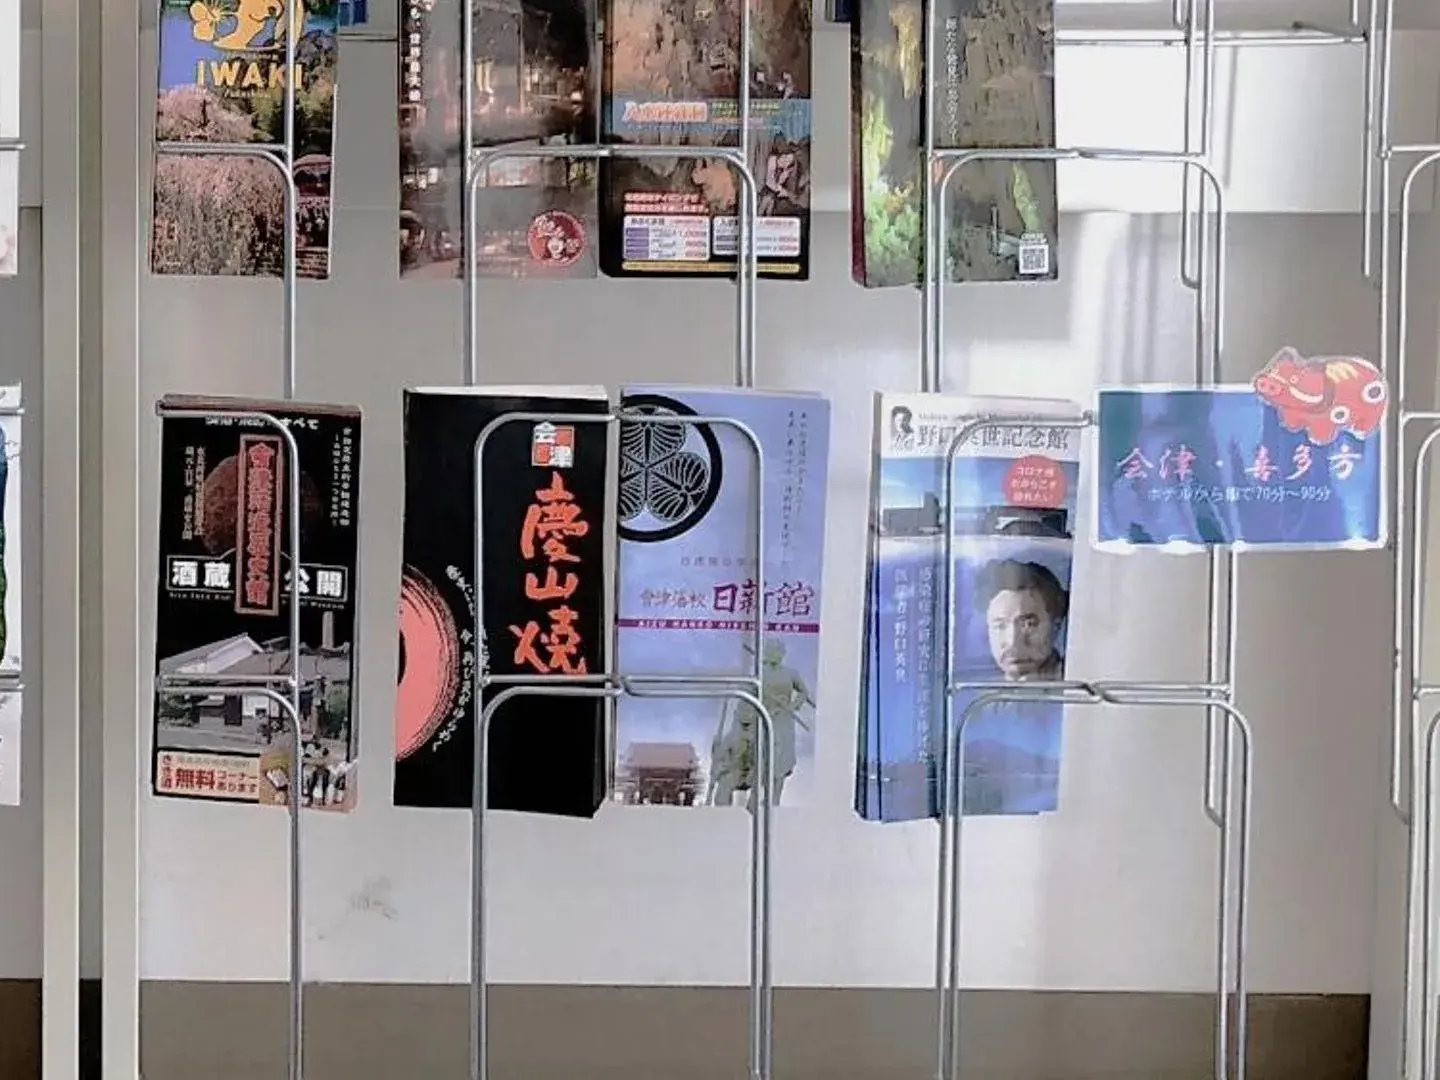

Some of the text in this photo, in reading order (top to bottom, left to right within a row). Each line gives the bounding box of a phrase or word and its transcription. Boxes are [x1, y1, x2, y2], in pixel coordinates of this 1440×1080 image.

[197, 59, 303, 90] IWAKI
[1116, 442, 1363, 482] 会津・喜多方
[172, 560, 344, 598] 酒蔵 公開
[175, 768, 215, 790] 無料
